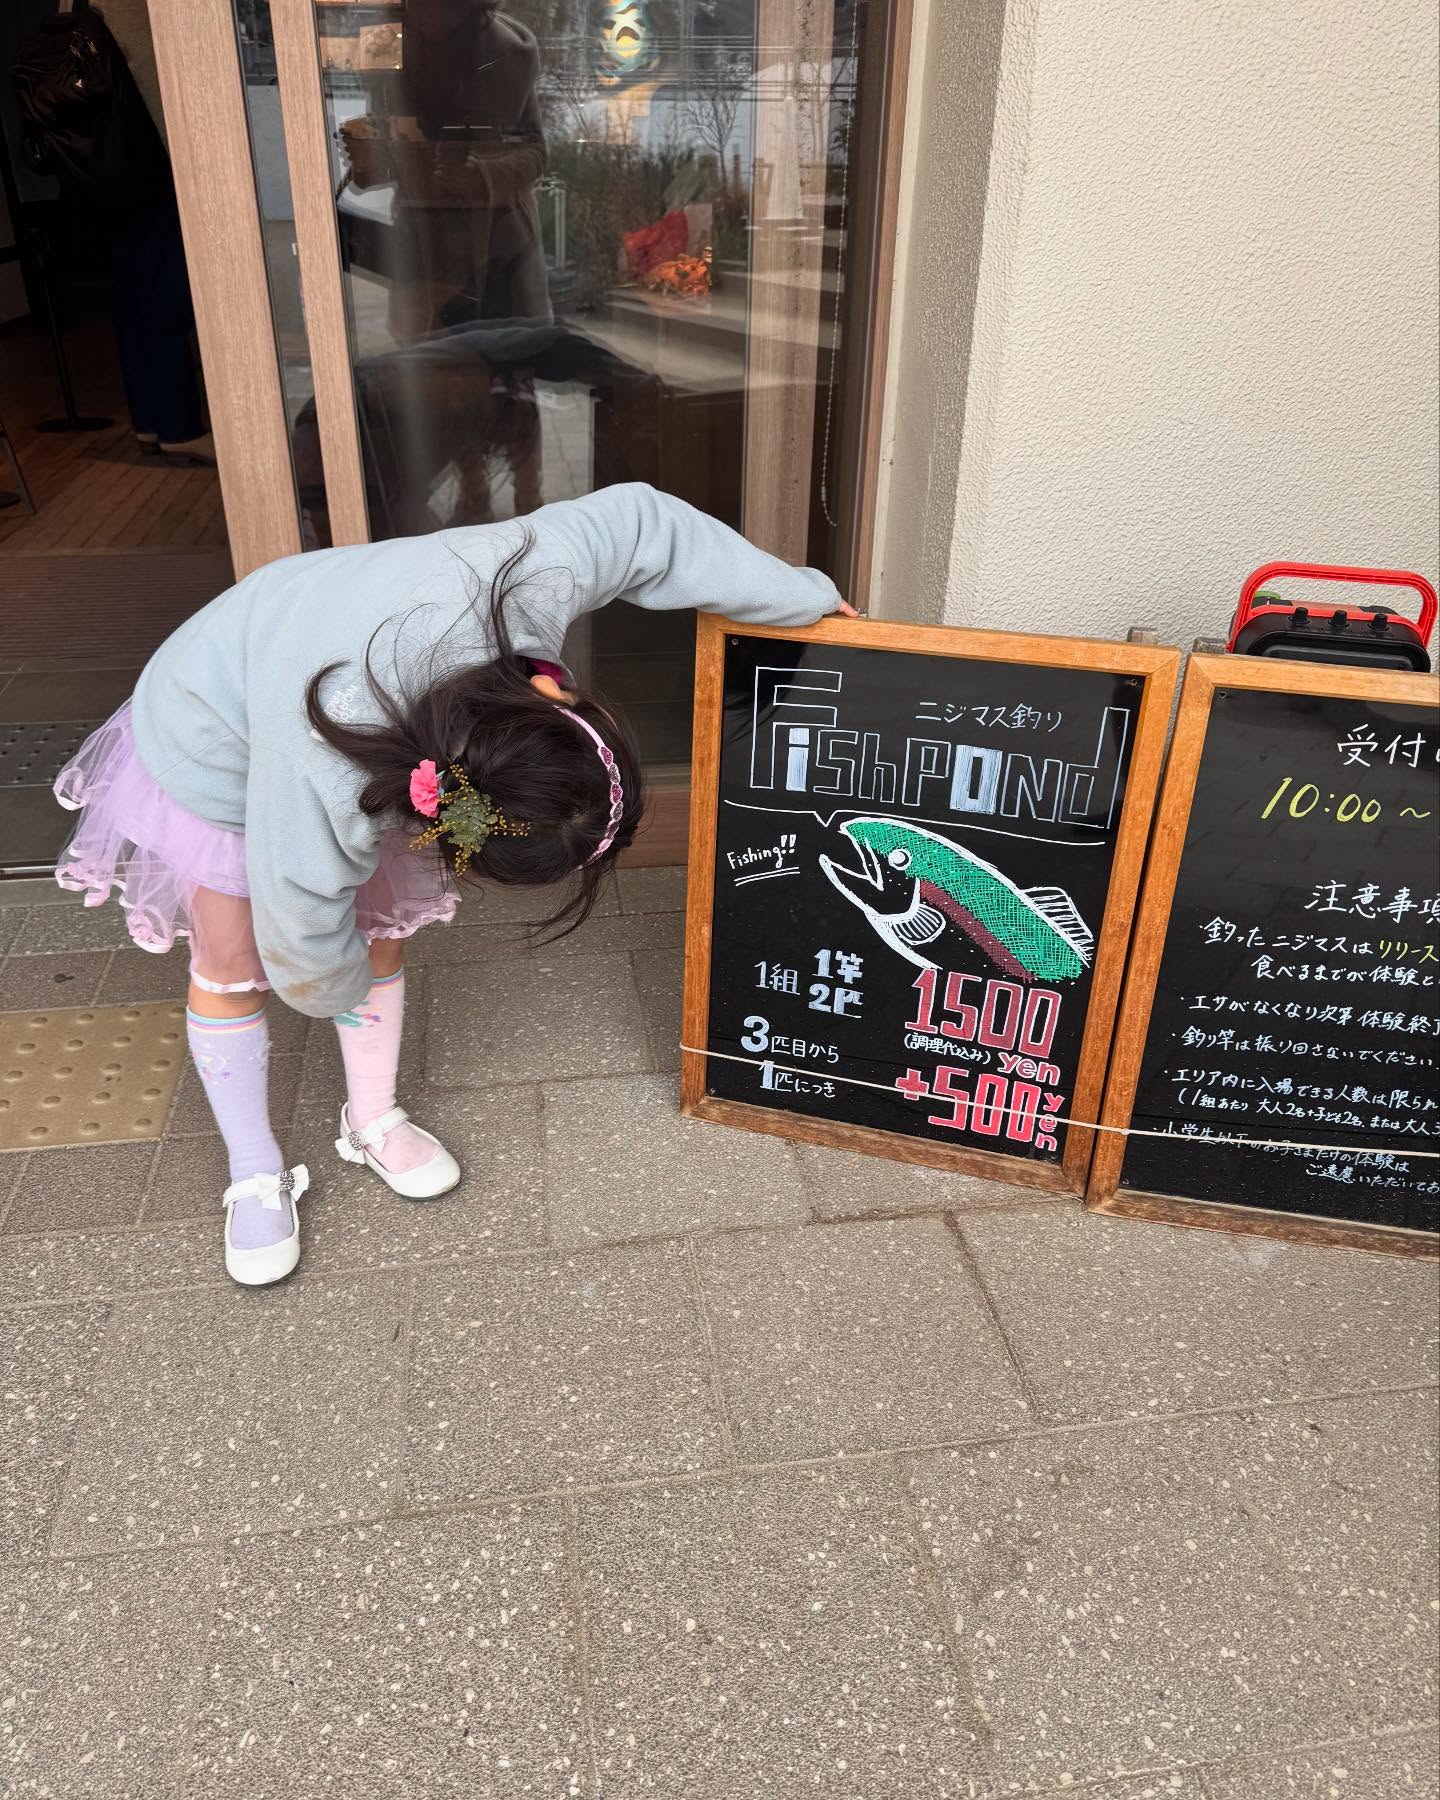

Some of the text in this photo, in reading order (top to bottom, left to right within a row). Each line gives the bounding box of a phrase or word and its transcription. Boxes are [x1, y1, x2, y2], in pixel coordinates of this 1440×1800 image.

[915, 702, 1062, 731] ニジマス釣り
[1337, 723, 1440, 768] 受付
[1261, 776, 1381, 823] 10:00
[726, 834, 798, 870] Fishing!!
[1250, 954, 1440, 987] 食べるまでが体験と
[905, 968, 1063, 1059] 1500
[997, 1052, 1061, 1086] yen
